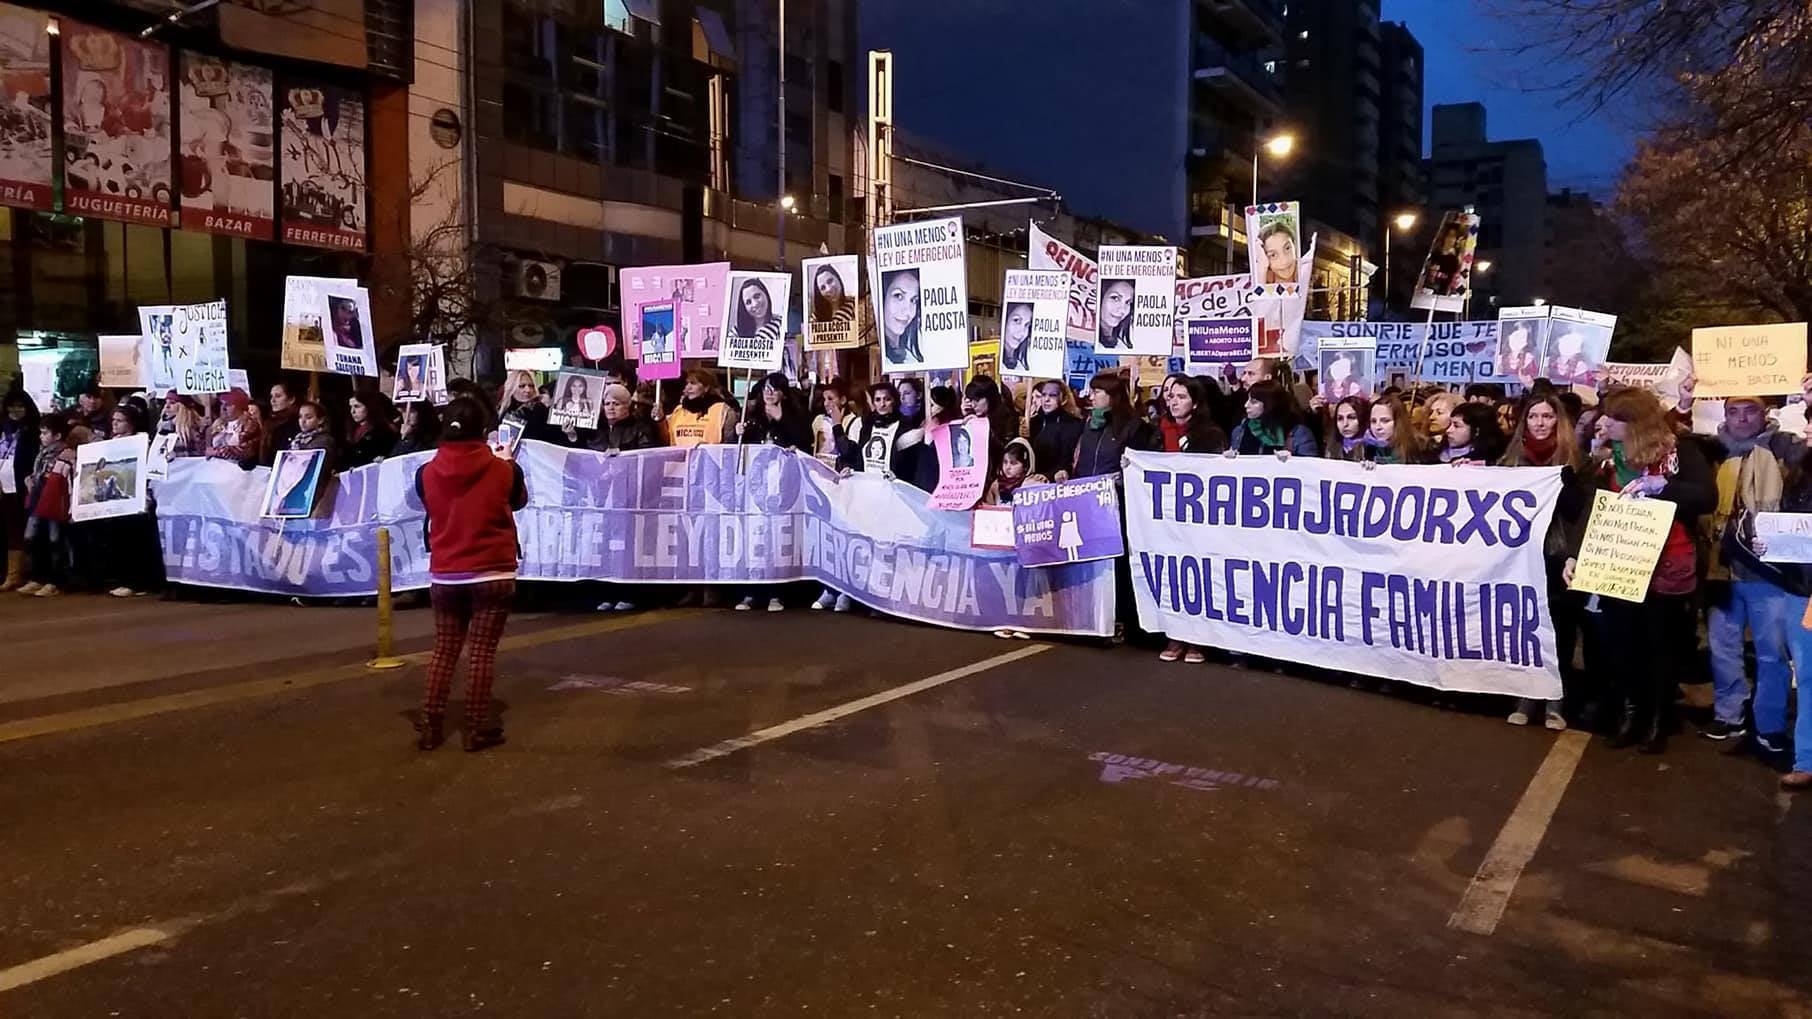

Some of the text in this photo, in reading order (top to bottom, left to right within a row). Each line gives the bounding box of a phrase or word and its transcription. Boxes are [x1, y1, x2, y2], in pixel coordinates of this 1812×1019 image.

[70, 195, 169, 221] JUGUETERÍA
[204, 215, 252, 233] BAZAR
[286, 227, 364, 249] FERRETERÍA
[878, 225, 947, 249] #NI UNA MENOS
[879, 251, 893, 267] LEY
[895, 250, 906, 265] DE
[1101, 250, 1162, 263] #NI UNA MENOS
[1099, 264, 1113, 276] LEY
[1114, 264, 1124, 276] DE
[1035, 275, 1059, 287] MENOS
[923, 286, 958, 307] PAOLA
[1137, 295, 1167, 309] PAOLA
[811, 321, 850, 333] PAOLA ACOSTA
[925, 311, 966, 332] ACOSTA
[1034, 318, 1060, 333] PAOLA
[1136, 313, 1172, 328] ACOSTA
[1331, 322, 1497, 341] SONRIE QUE TE
[729, 337, 773, 350] PAOLA ACOSTA
[1033, 336, 1063, 351] ACOSTA
[1375, 341, 1466, 359] ERMOSO
[1715, 335, 1769, 349] NI UNA
[1433, 360, 1495, 378] MENO
[1728, 352, 1778, 369] MENOS
[1143, 470, 1538, 549] TRABAJADORXS
[989, 561, 1054, 617] YA
[1139, 551, 1544, 668] VIOLENCIA FAMILIAR
